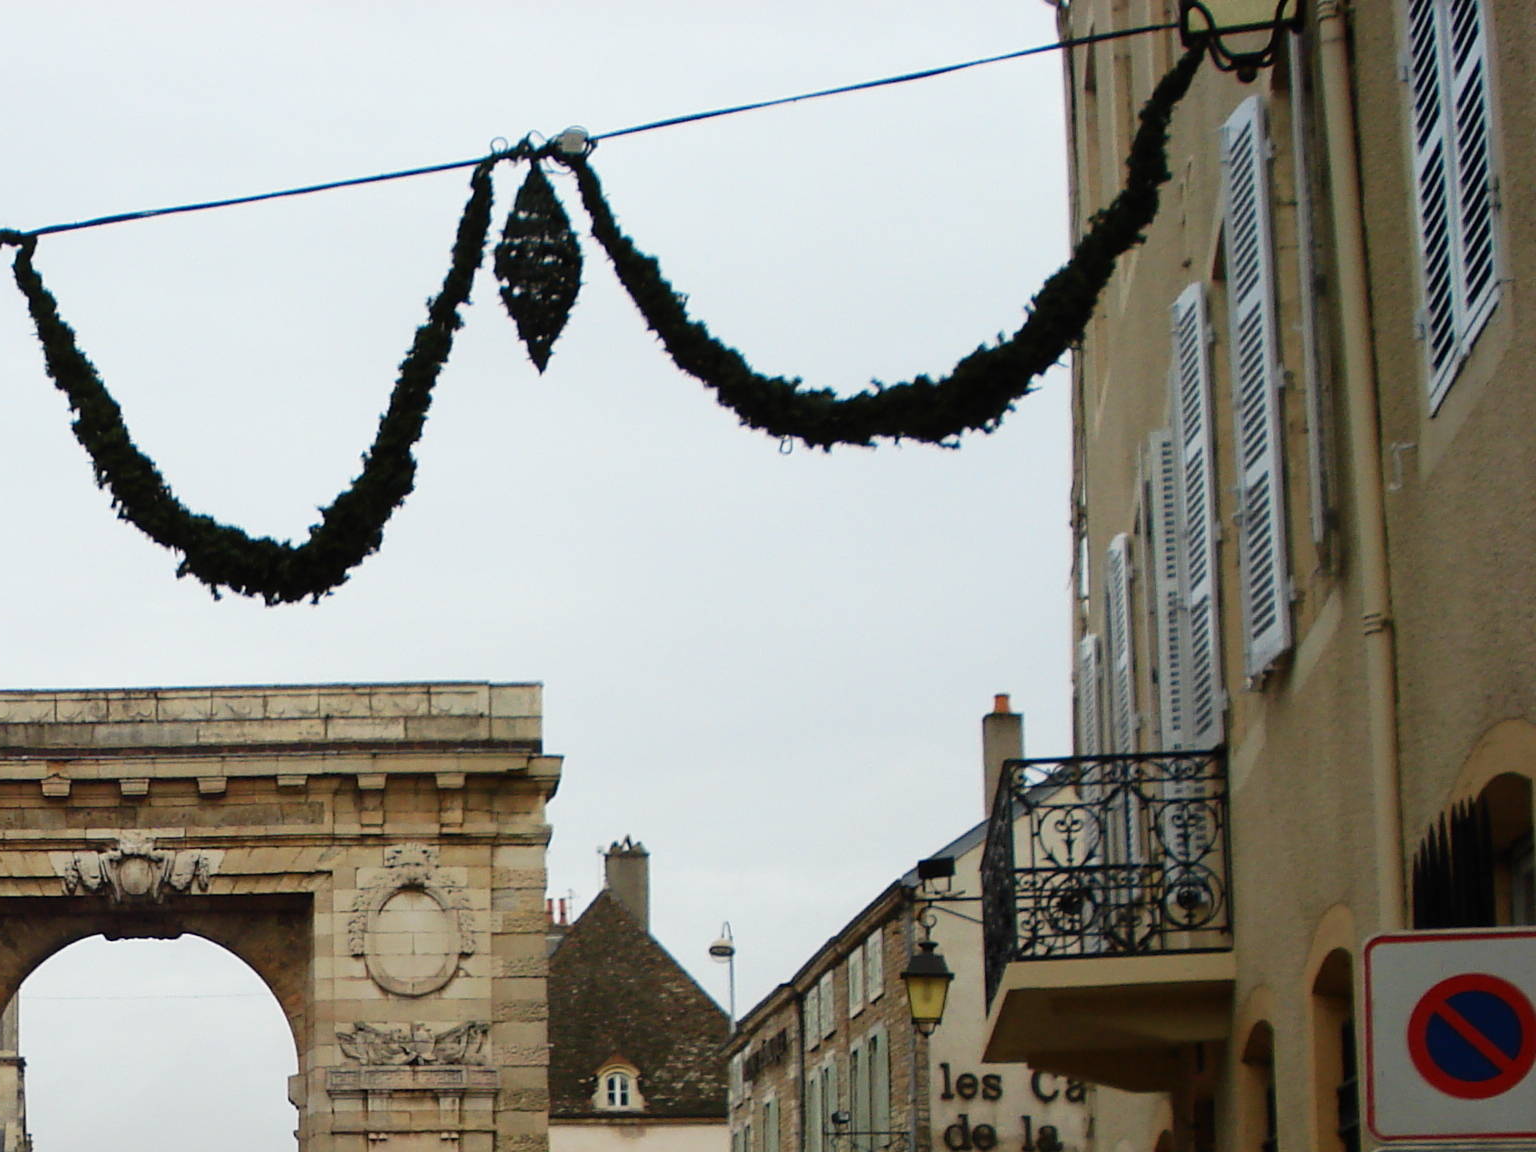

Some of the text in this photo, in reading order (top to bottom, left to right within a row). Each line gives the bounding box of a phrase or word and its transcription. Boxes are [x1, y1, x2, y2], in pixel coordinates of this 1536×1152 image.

[939, 1062, 1003, 1100] les
[943, 1113, 1064, 1152] de la
